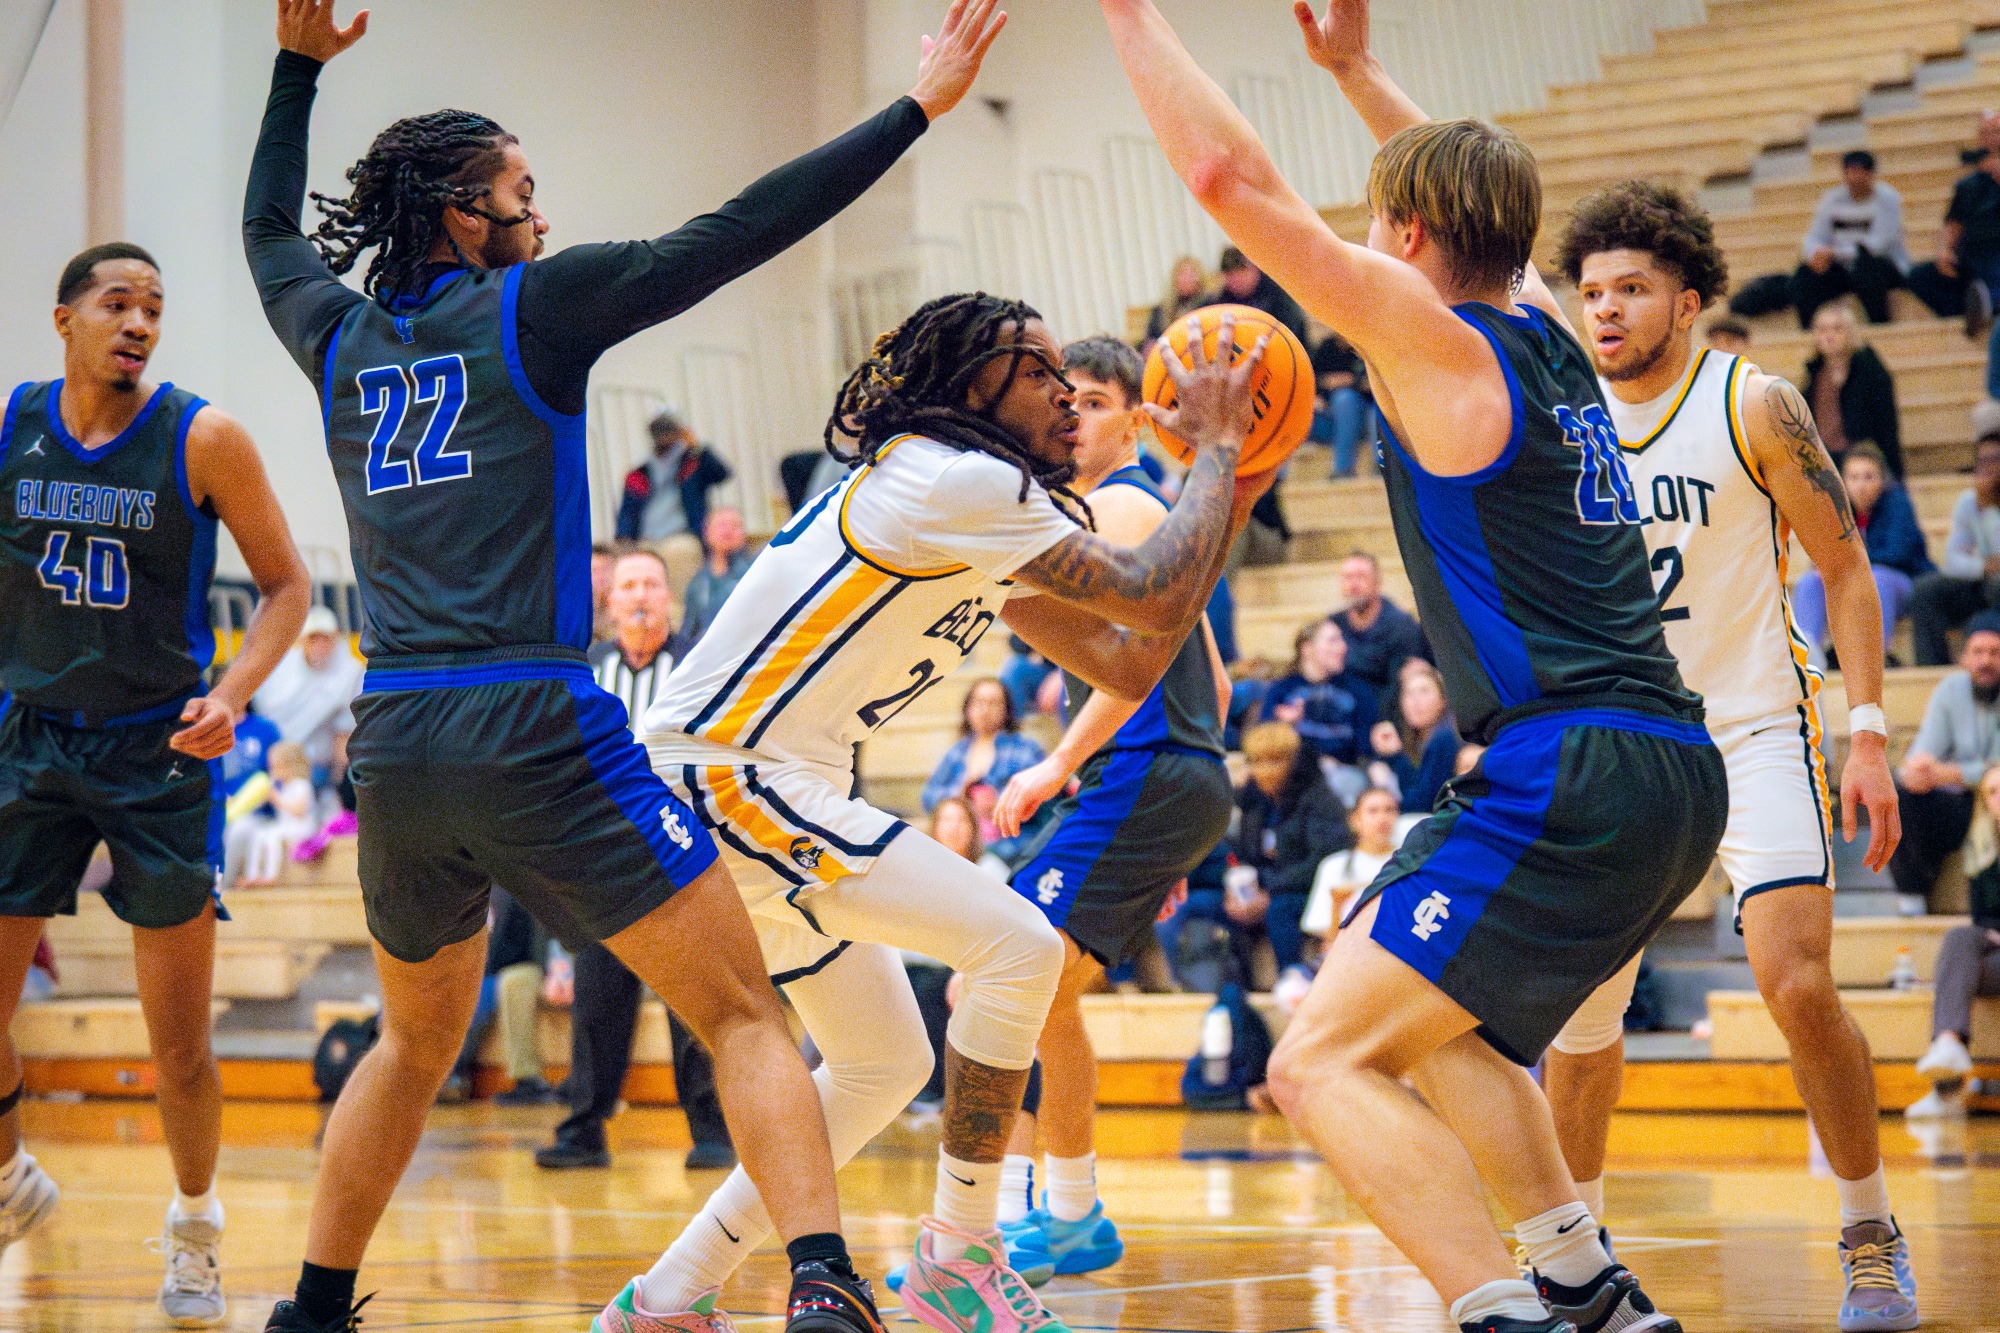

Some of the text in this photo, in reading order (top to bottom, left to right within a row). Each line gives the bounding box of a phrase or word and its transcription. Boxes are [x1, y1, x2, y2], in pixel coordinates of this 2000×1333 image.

[355, 354, 473, 496] 22
[17, 479, 156, 530] BLUEBOYS
[37, 531, 131, 610] 40
